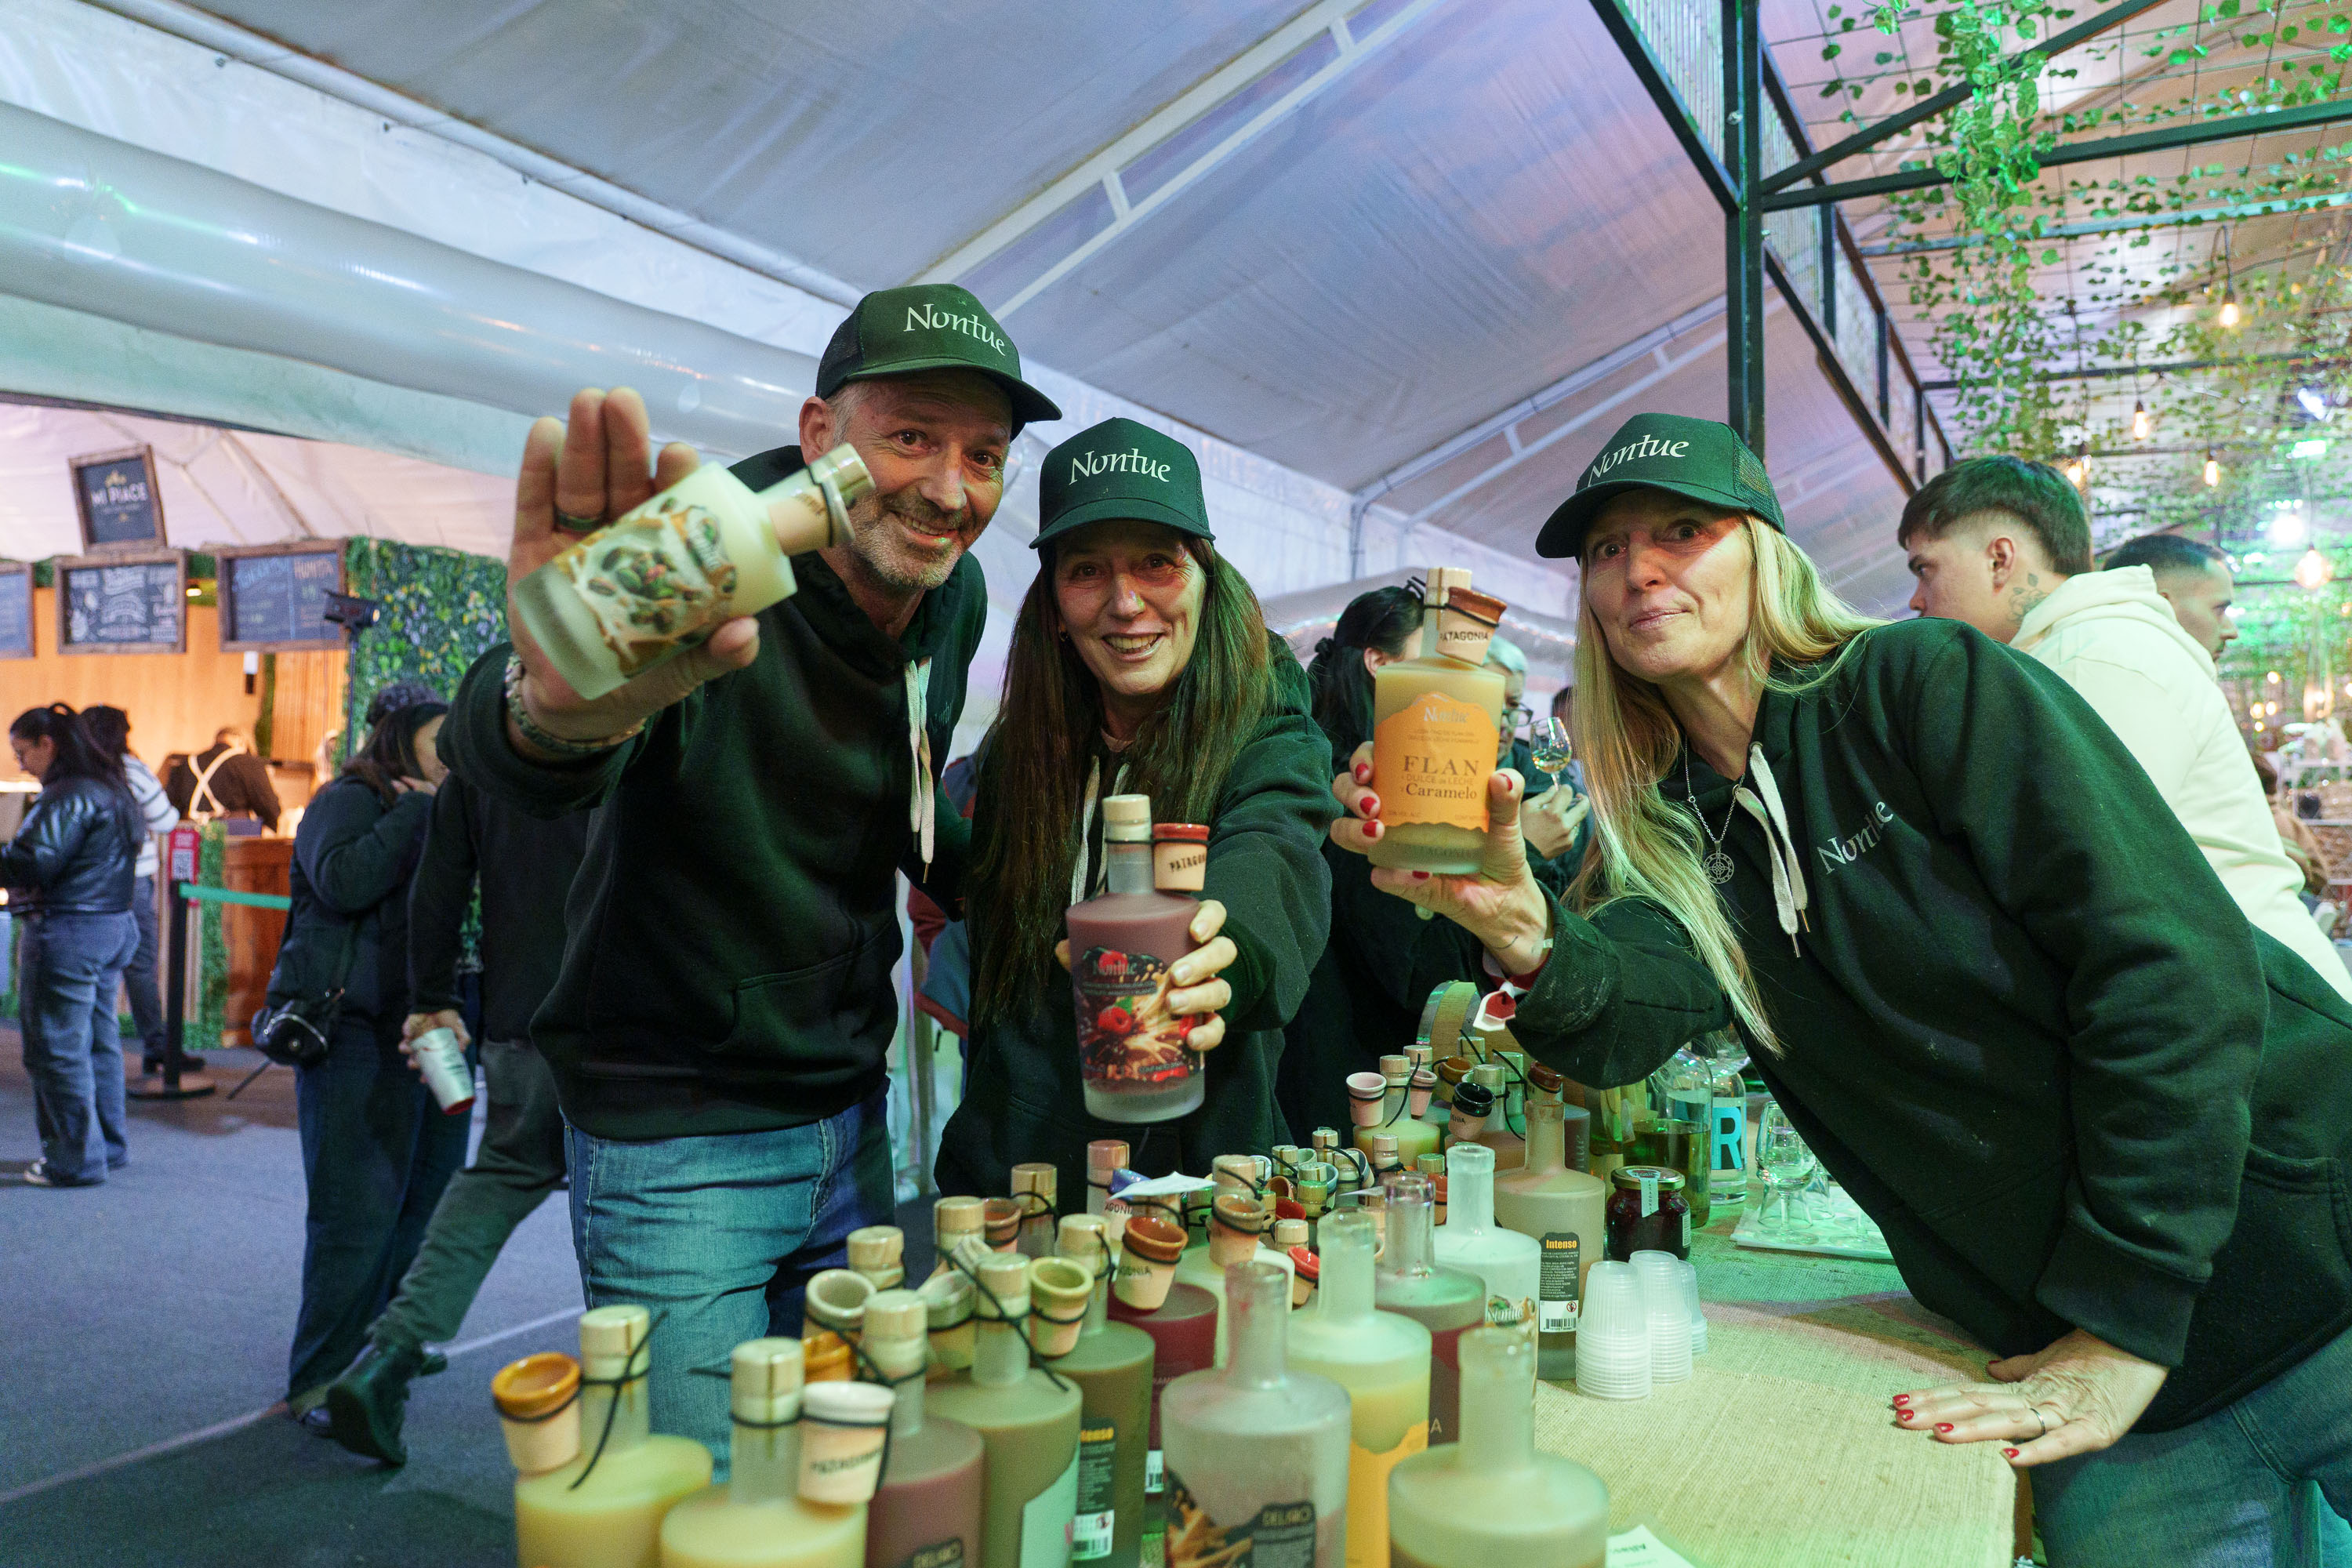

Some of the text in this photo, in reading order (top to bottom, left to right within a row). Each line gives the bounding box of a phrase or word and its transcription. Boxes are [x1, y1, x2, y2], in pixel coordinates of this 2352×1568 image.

[903, 303, 1006, 356] Nontue
[1069, 448, 1171, 485] Nontue
[1587, 434, 1690, 488] Nontue
[1403, 755, 1480, 776] FLAN
[1406, 782, 1478, 800] Caramelo
[1546, 1239, 1577, 1250] Intenso
